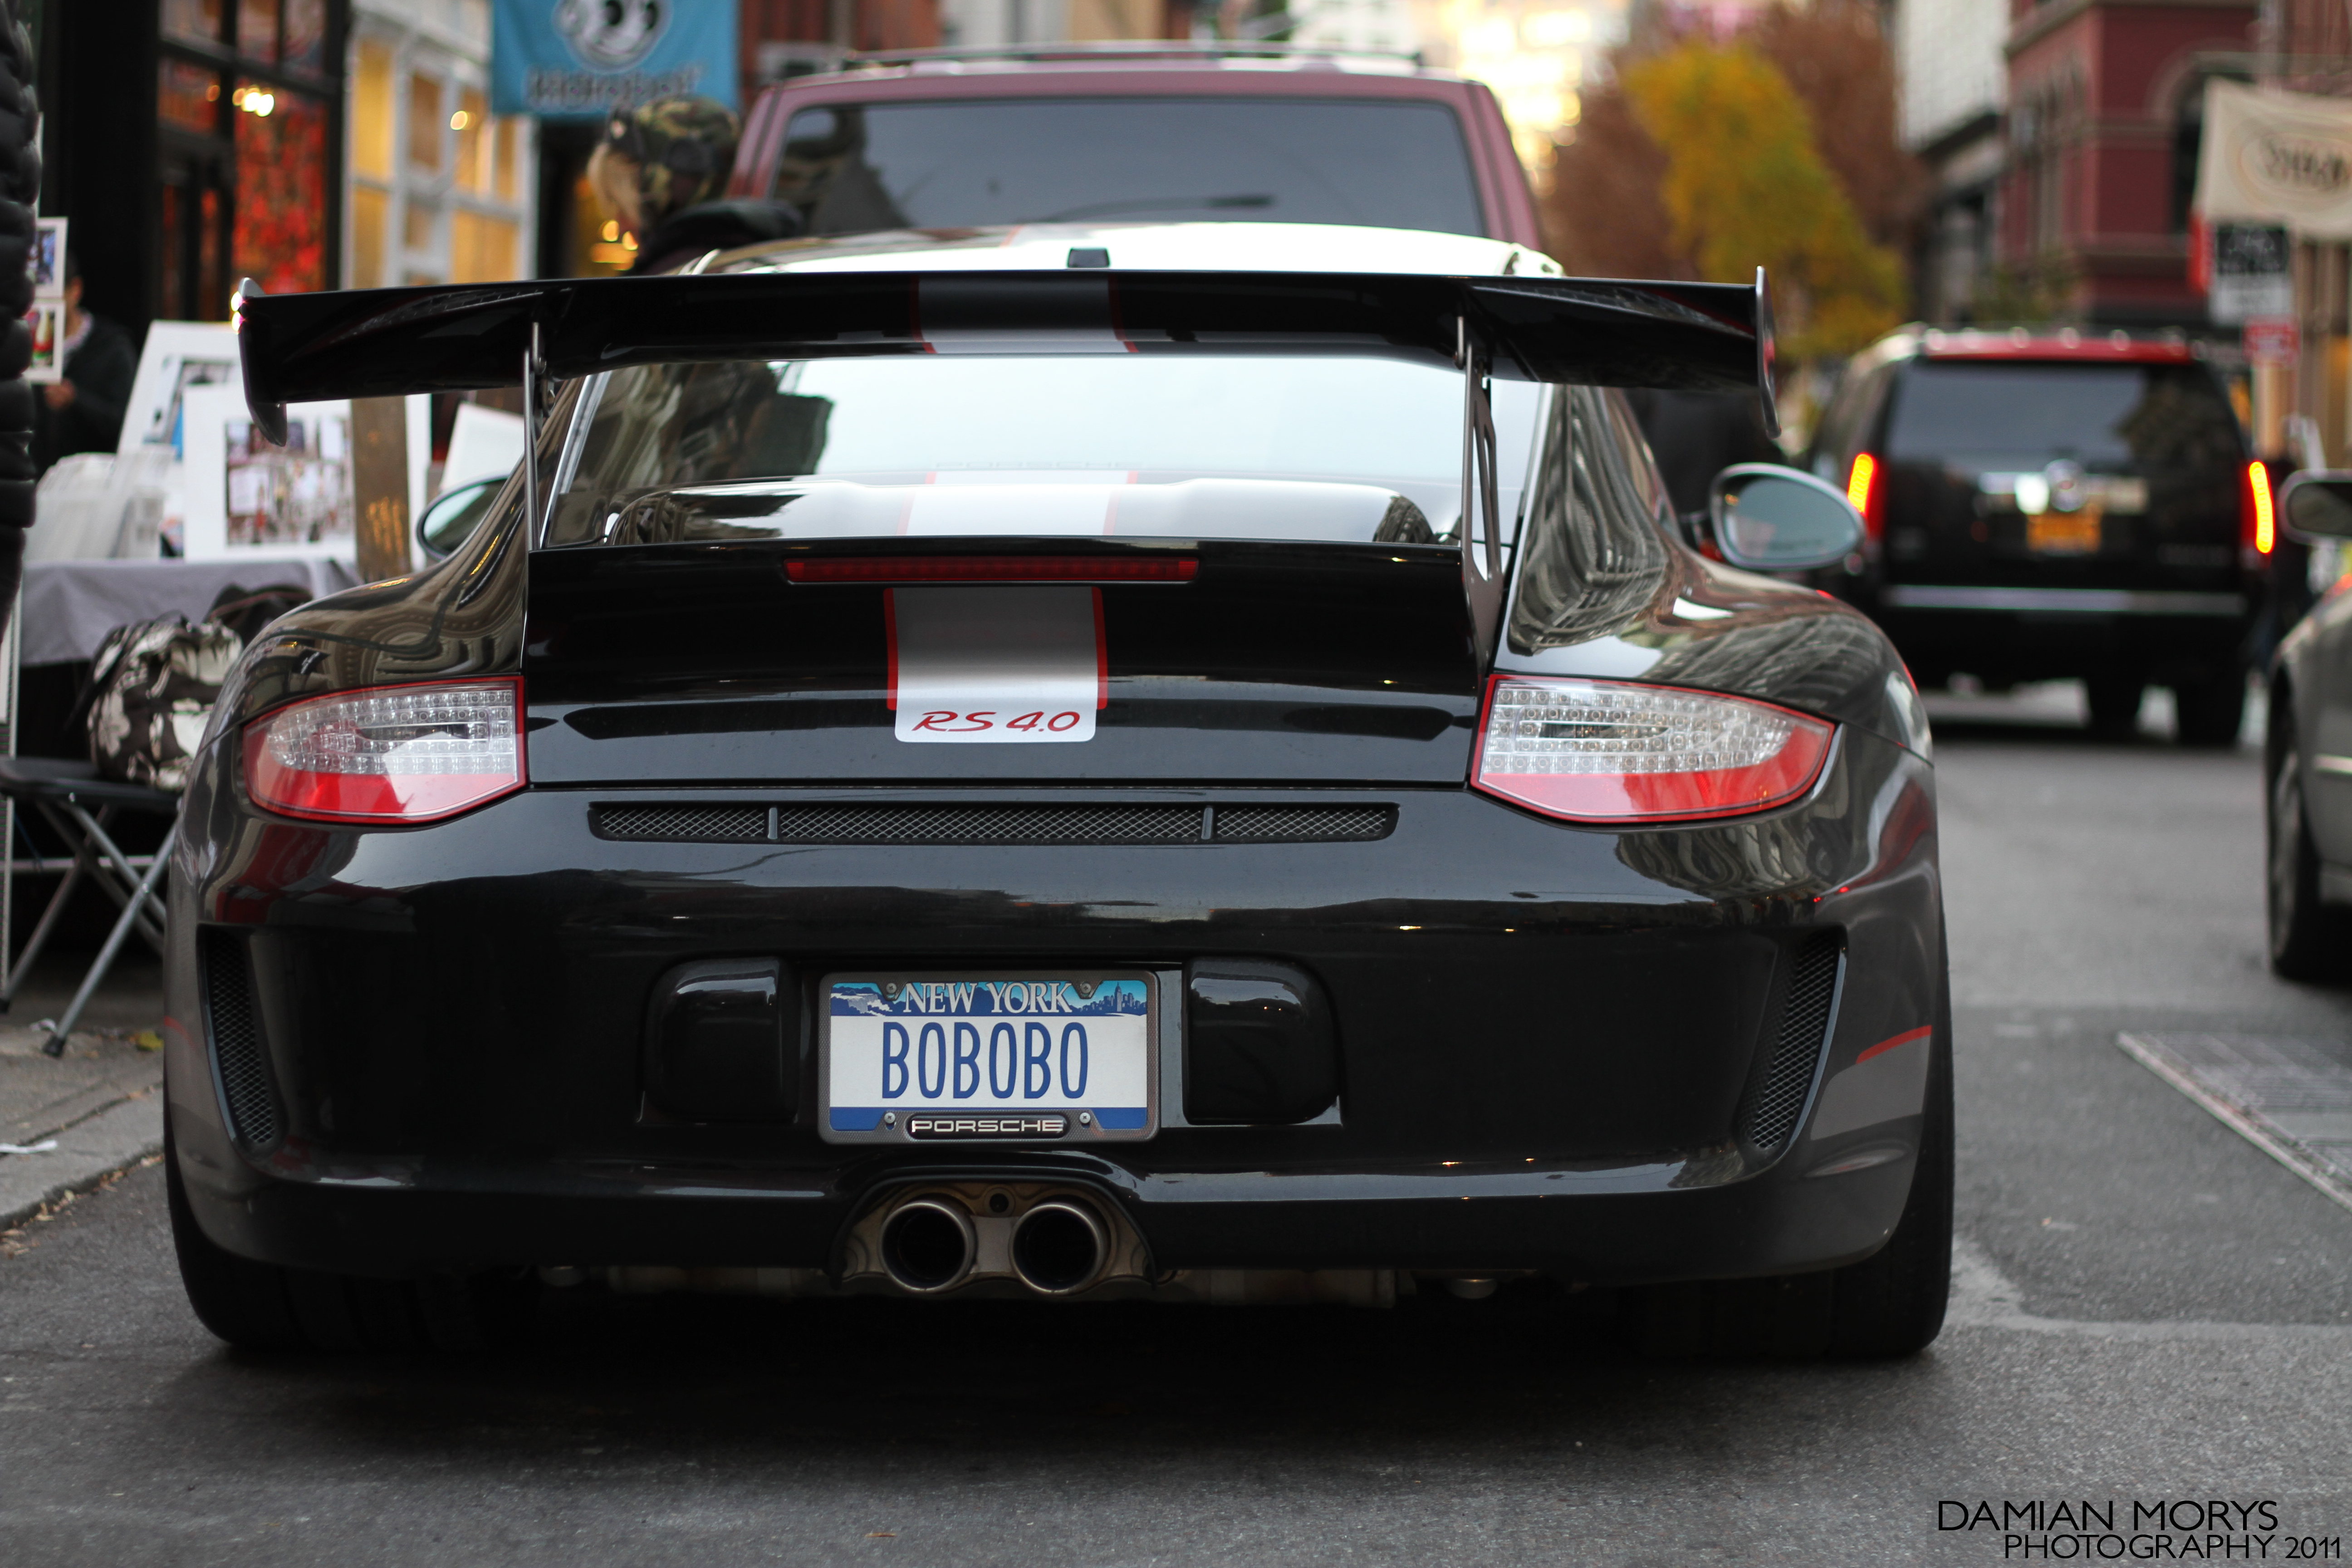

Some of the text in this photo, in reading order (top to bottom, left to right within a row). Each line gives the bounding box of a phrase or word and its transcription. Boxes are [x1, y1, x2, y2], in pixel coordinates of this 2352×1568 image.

[911, 710, 1080, 732] RS 4.0
[903, 982, 1073, 1014] NEW YORK
[911, 1119, 1064, 1133] PORSCHE
